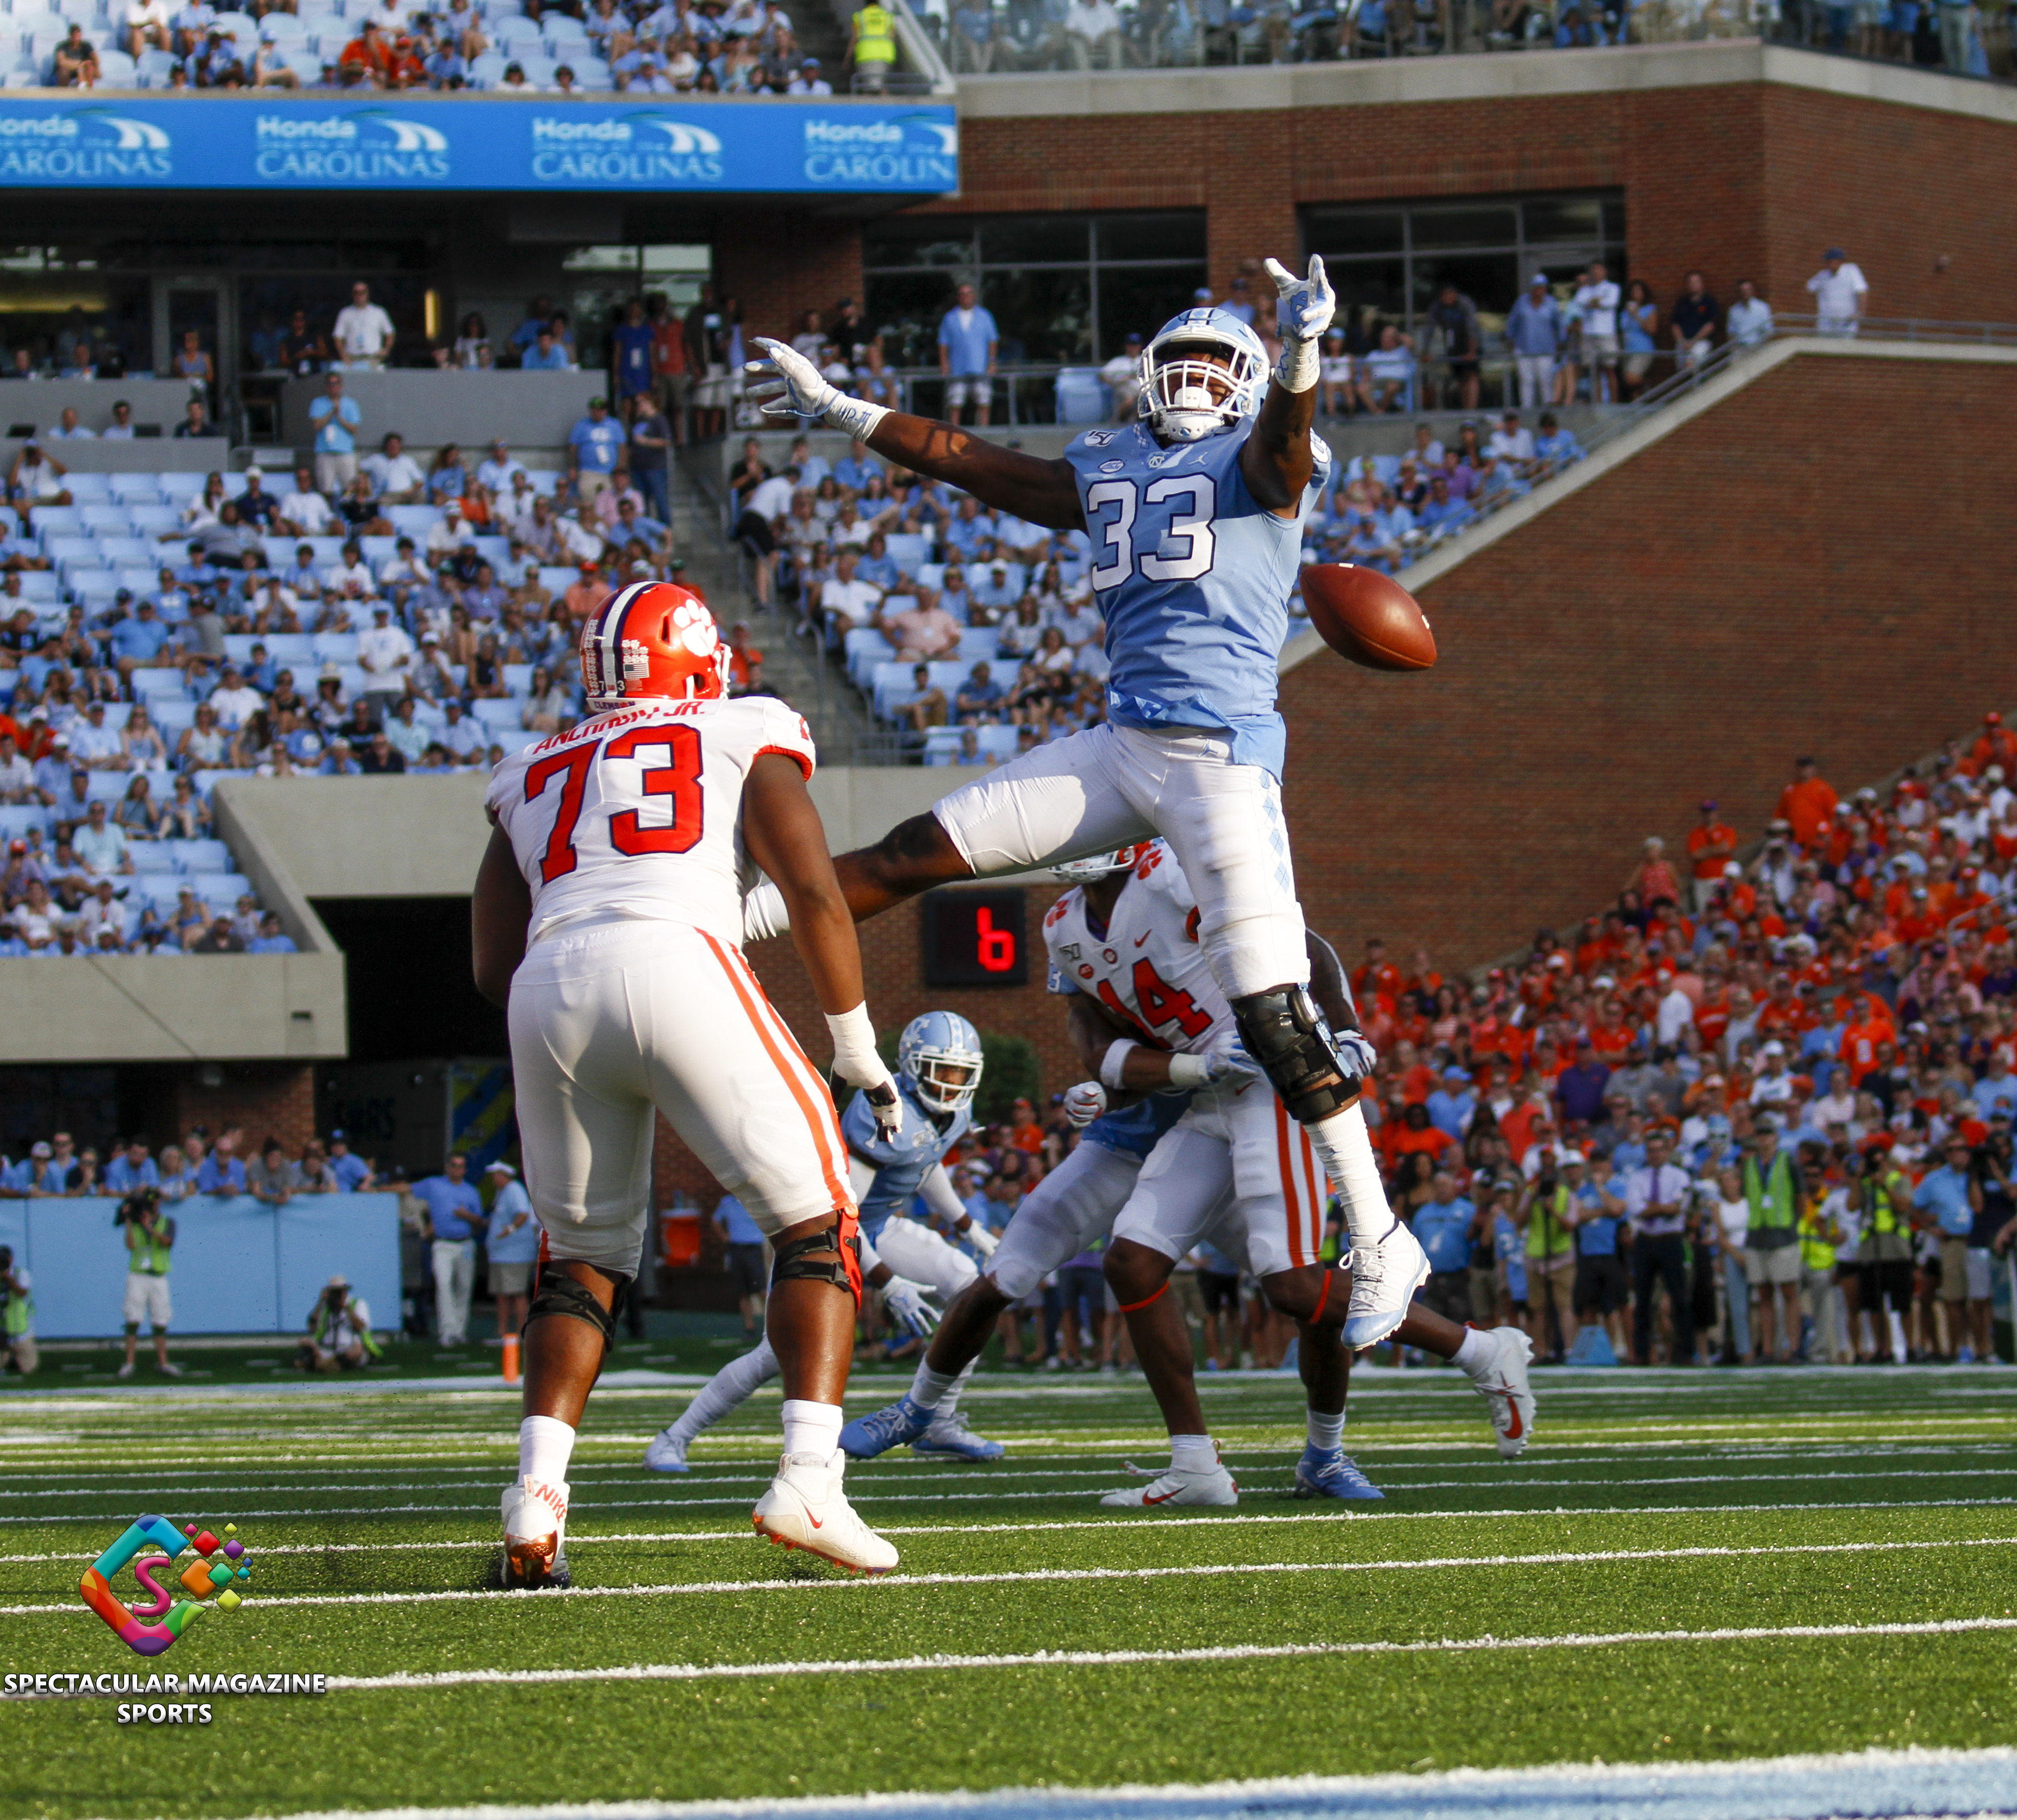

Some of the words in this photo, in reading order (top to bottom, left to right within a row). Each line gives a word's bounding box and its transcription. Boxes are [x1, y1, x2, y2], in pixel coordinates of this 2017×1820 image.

[0, 114, 78, 136] onda
[257, 116, 357, 139] Honda
[533, 118, 631, 141] Honda
[805, 120, 902, 142] Honda
[0, 150, 171, 178] AROLINAS
[257, 150, 450, 179] CAROLINAS
[533, 152, 723, 182] CAROLINAS
[1087, 472, 1217, 593] 33
[524, 723, 704, 887] 73
[976, 906, 1016, 972] 6
[1097, 956, 1214, 1050] 14
